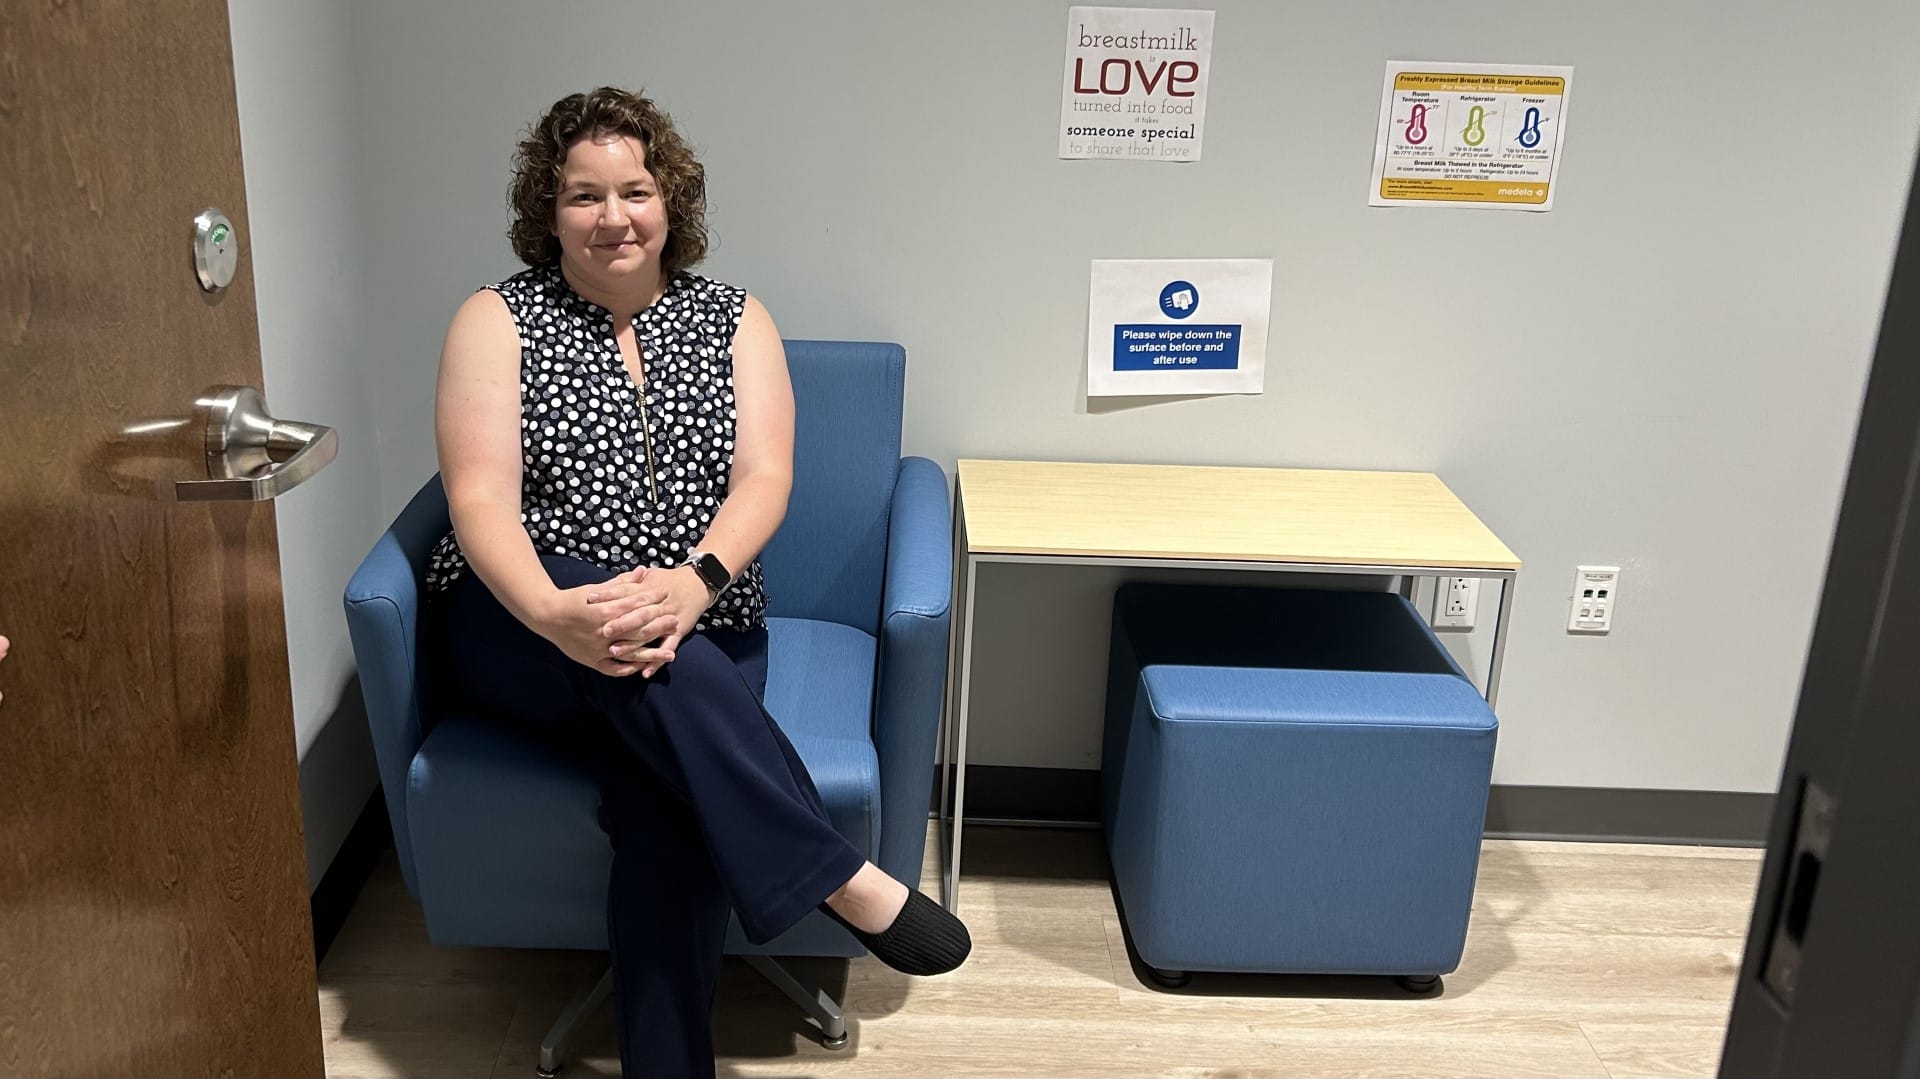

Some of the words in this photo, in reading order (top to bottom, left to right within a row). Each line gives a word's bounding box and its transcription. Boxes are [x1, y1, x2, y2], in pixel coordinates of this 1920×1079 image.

[1078, 24, 1197, 50] breastmilk
[1400, 75, 1423, 84] Freshly
[1425, 76, 1458, 84] Expressed
[1073, 97, 1121, 113] turned
[1127, 99, 1156, 114] into
[1160, 98, 1193, 115] food
[1067, 126, 1135, 138] someone
[1141, 124, 1195, 142] special
[1070, 142, 1081, 154] to
[1087, 139, 1123, 156] share
[1128, 141, 1155, 157] that
[1160, 142, 1190, 157] love
[1498, 188, 1533, 196] medela
[1122, 330, 1156, 339] Please
[1158, 330, 1182, 341] wipe
[1185, 330, 1212, 339] down
[1215, 330, 1232, 339] the
[1129, 342, 1167, 352] surface
[1169, 342, 1202, 352] before
[1204, 342, 1224, 352] and
[1153, 355, 1177, 365] after
[1178, 356, 1198, 364] use
